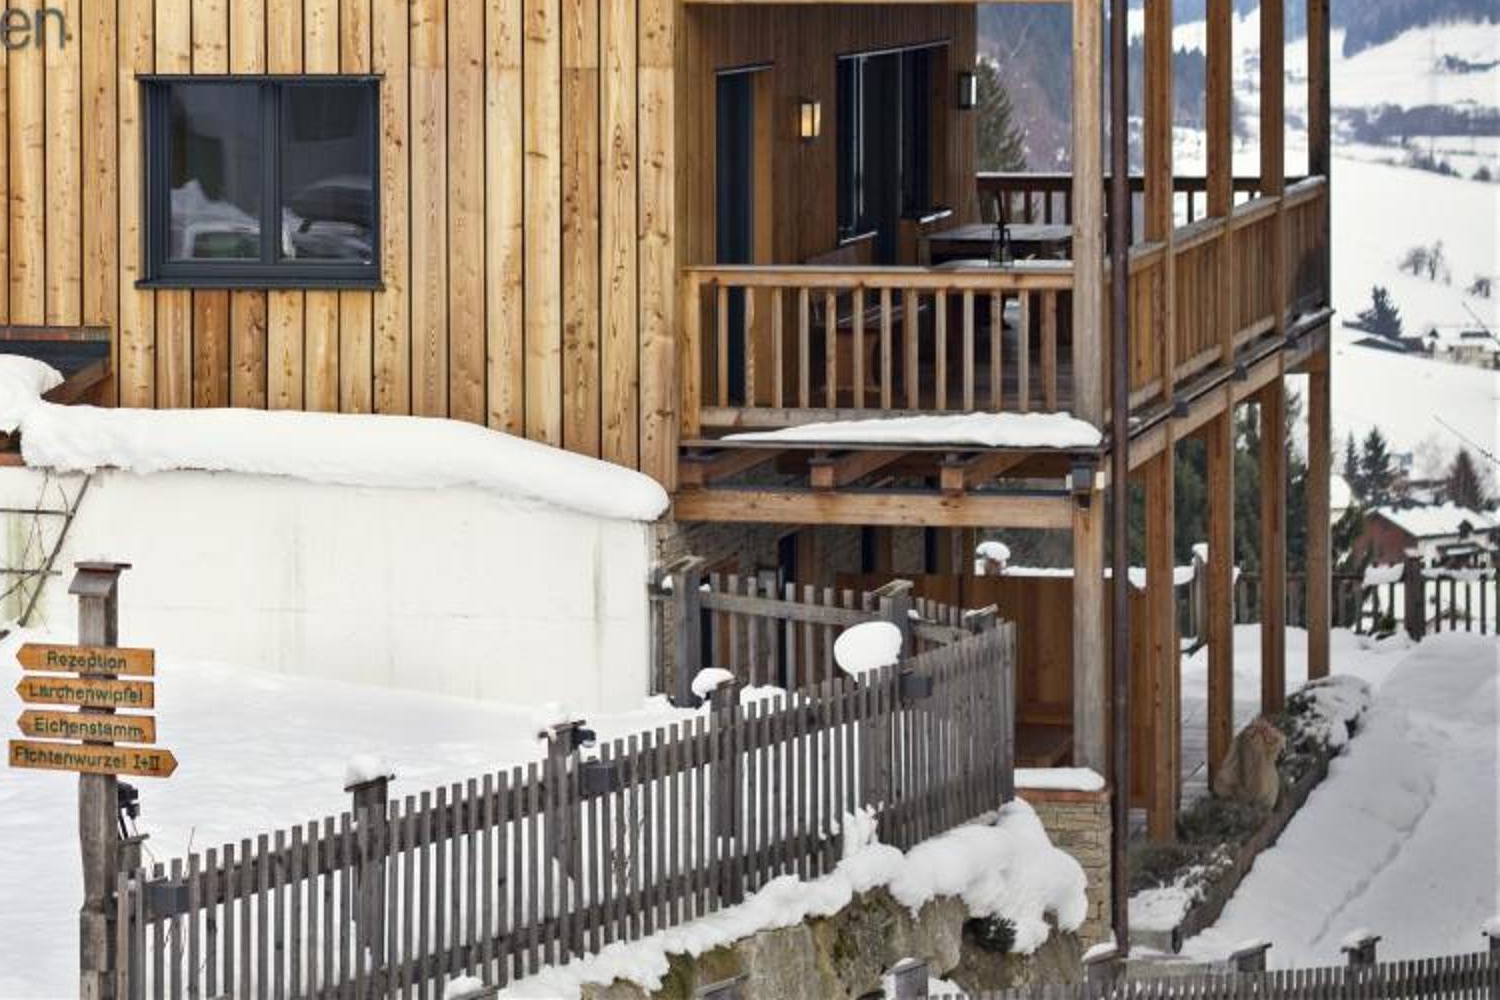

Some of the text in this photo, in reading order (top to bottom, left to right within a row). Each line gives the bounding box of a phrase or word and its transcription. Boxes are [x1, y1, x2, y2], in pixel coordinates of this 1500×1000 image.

[46, 651, 127, 669] Rezeption
[34, 717, 144, 737] Eichenstamm
[15, 746, 126, 769] Fichtenwurzel
